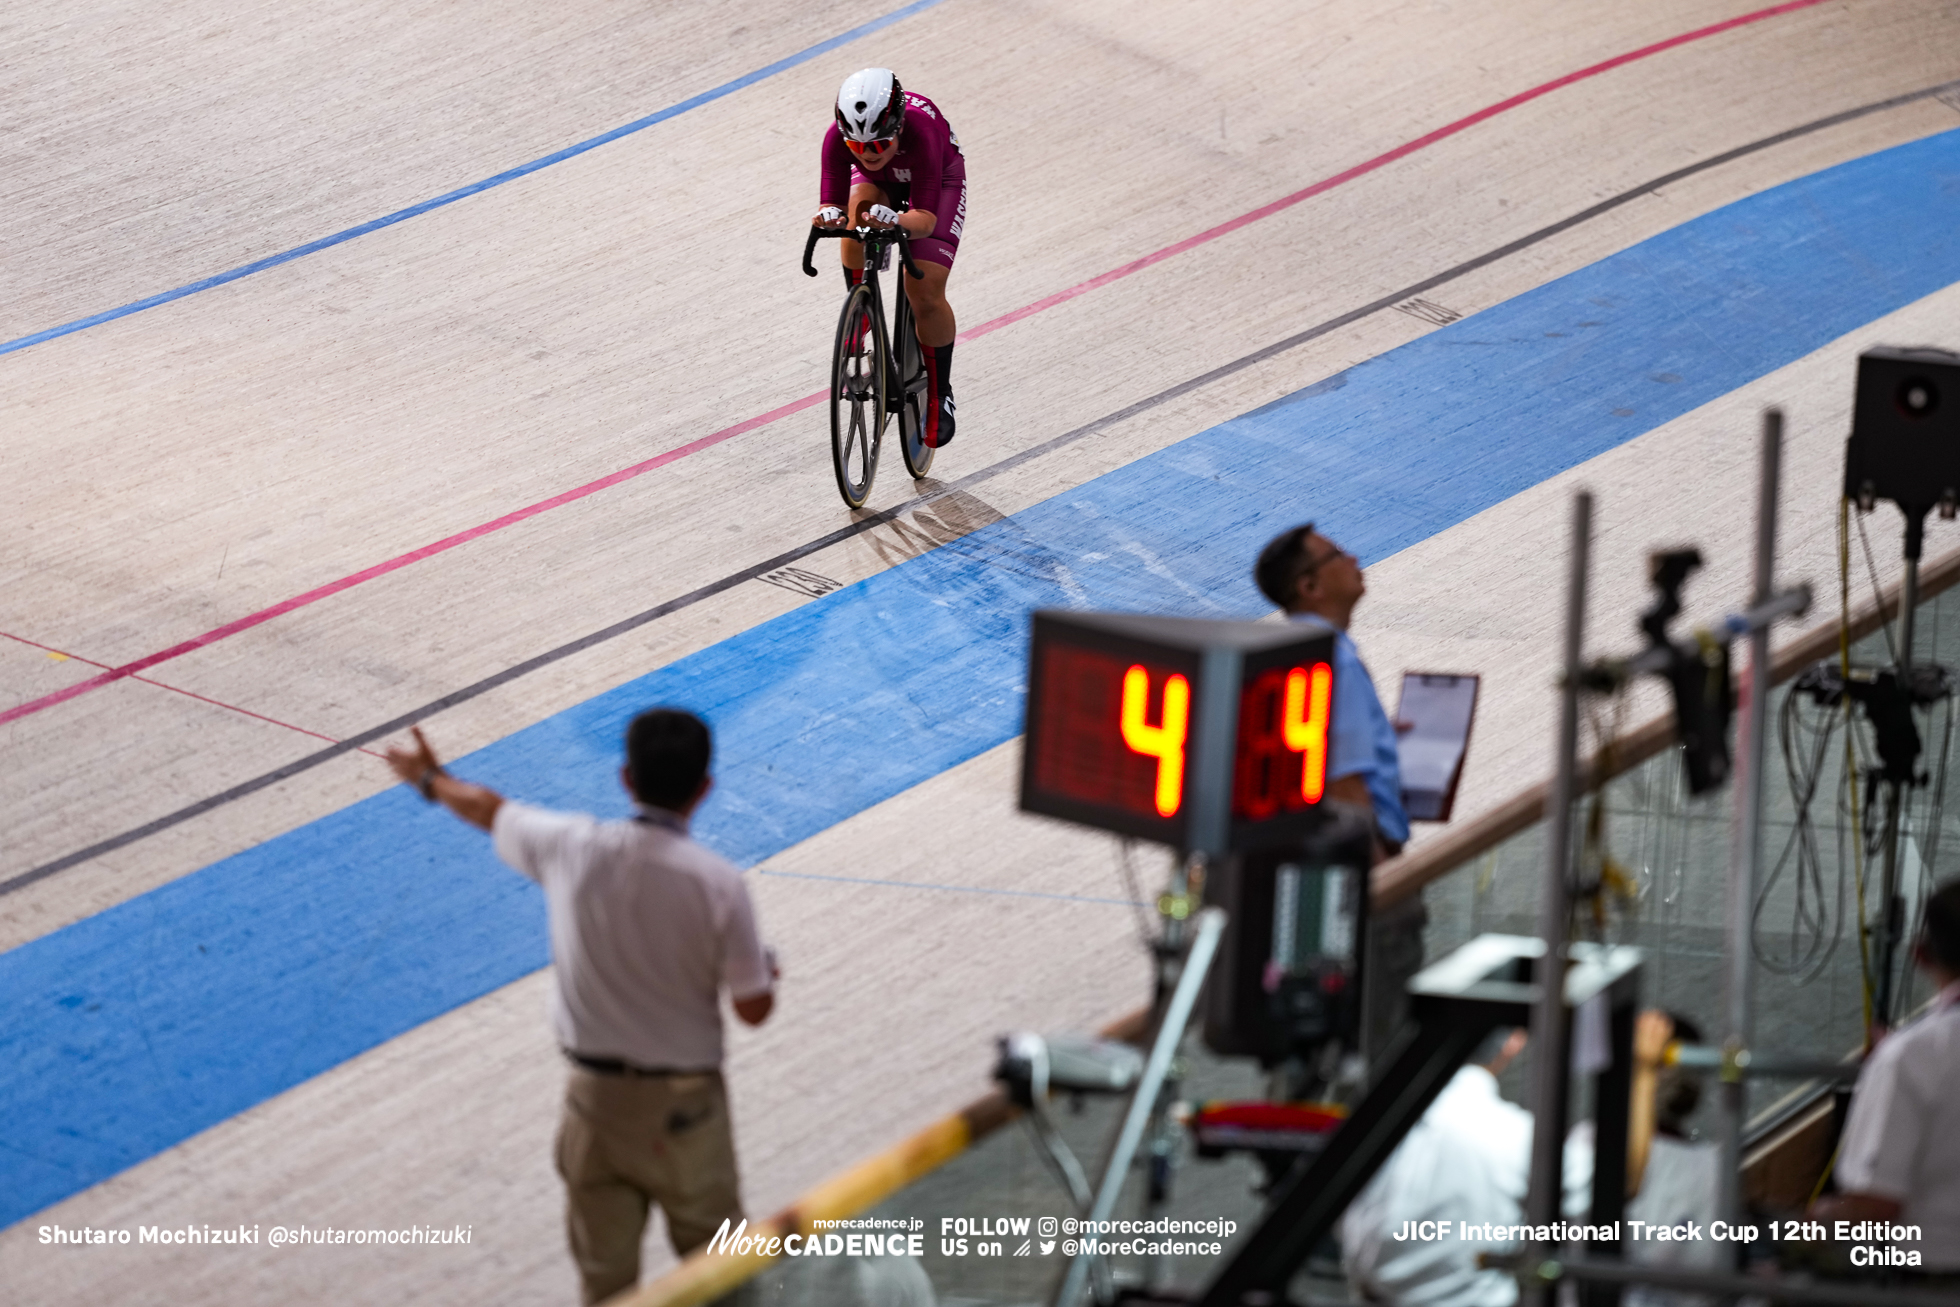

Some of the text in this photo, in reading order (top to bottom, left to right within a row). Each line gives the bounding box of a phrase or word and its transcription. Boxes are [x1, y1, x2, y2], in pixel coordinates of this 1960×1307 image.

[766, 567, 844, 596] 230
[1120, 664, 1190, 817] 4
[1281, 662, 1333, 804] 4
